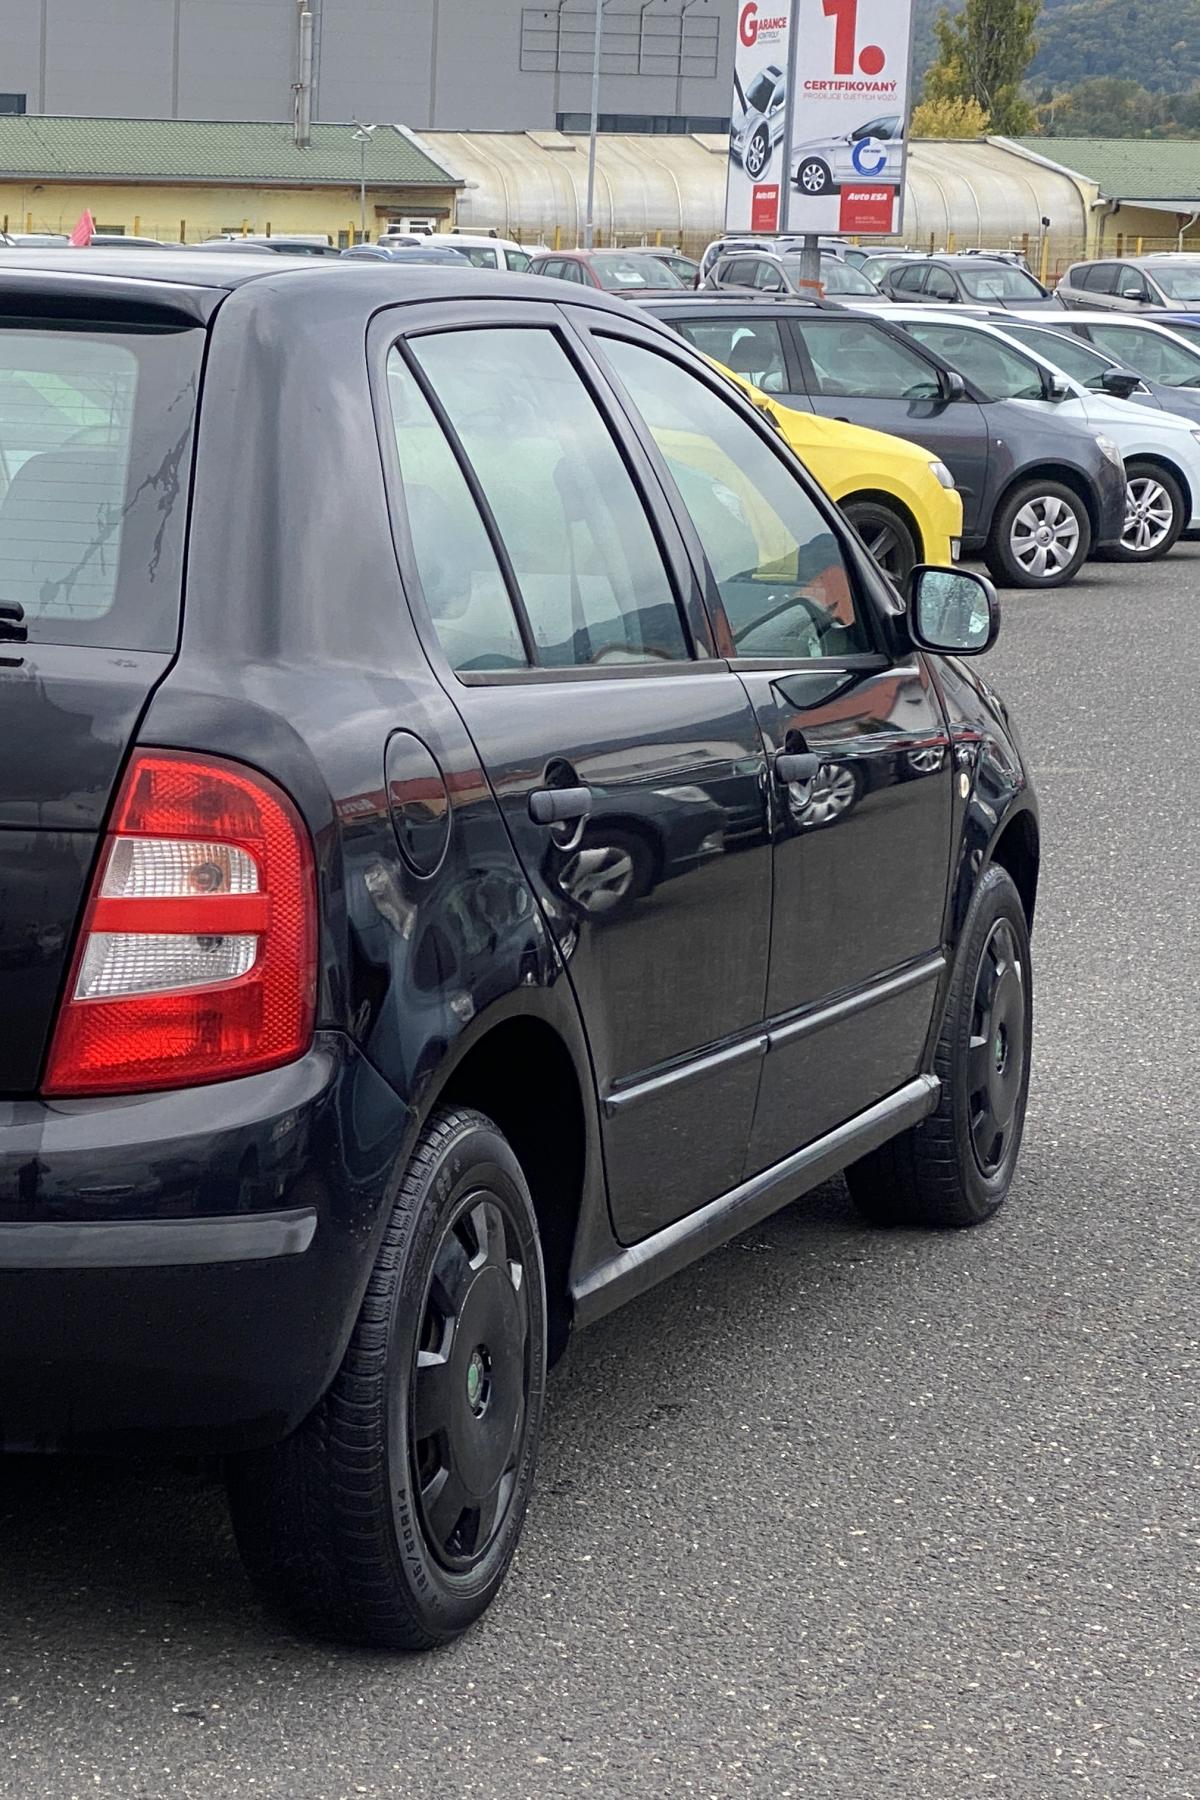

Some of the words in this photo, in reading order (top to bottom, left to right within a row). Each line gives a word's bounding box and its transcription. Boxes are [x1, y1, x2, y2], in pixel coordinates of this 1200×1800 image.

[822, 0, 886, 75] 1.
[803, 80, 897, 92] CERTIFIKOVANÝ
[847, 193, 870, 201] Auto
[870, 193, 888, 201] ESA
